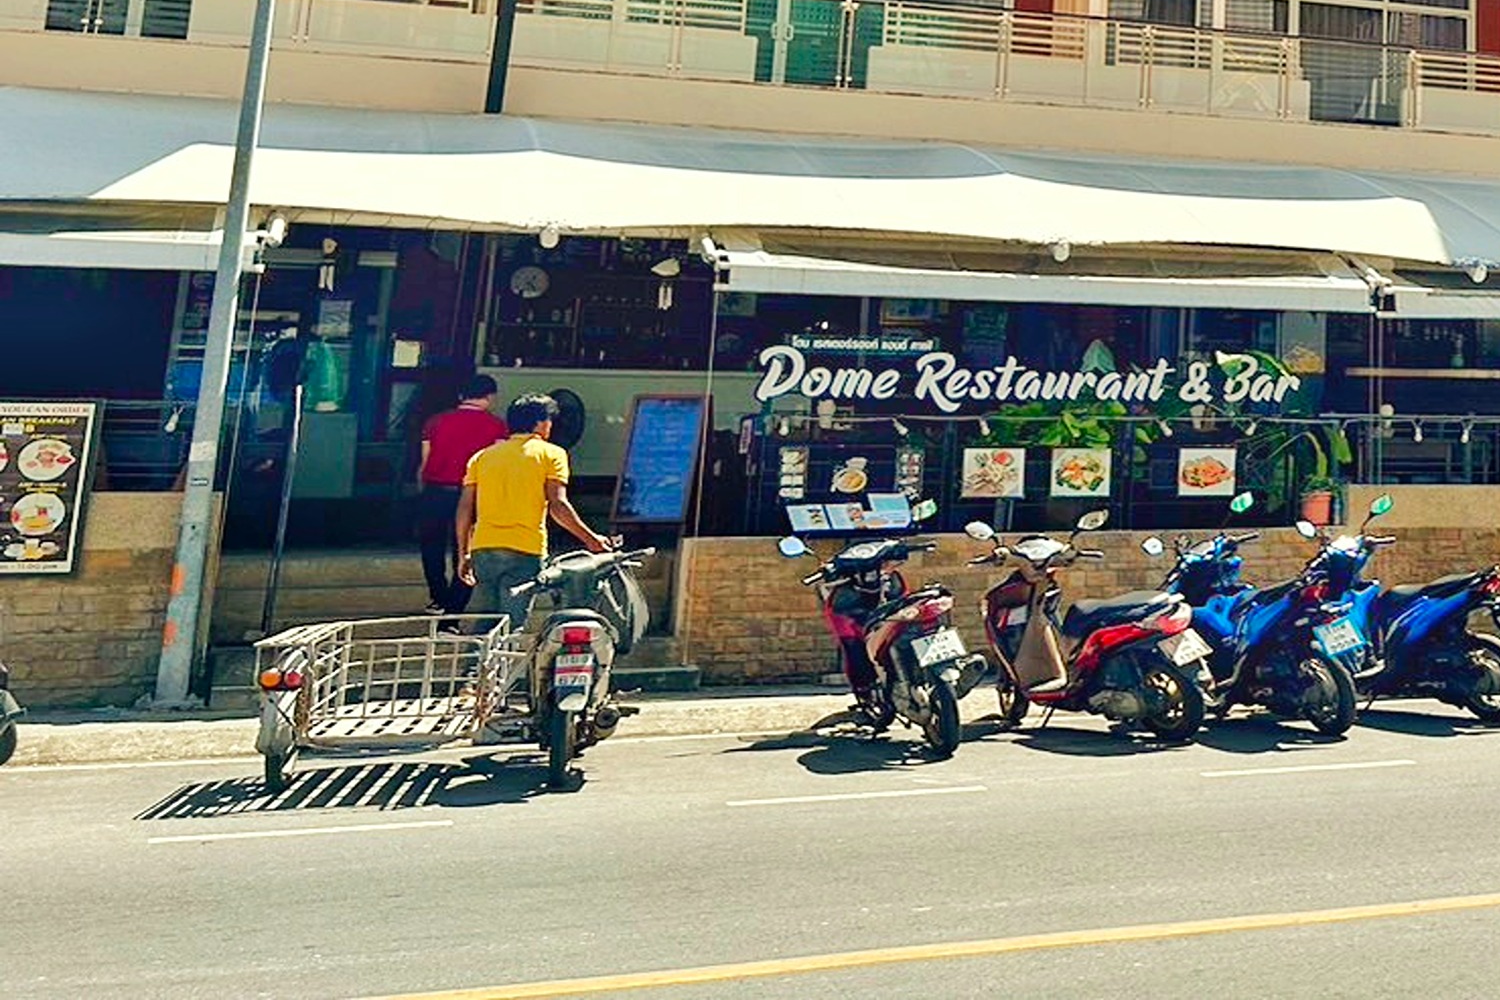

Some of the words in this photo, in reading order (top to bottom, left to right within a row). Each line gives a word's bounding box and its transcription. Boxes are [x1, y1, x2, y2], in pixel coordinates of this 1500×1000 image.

[756, 345, 900, 402] Dome
[914, 352, 1176, 413] Restaurant
[1179, 362, 1213, 402] &
[1218, 352, 1300, 402] Bar
[26, 405, 50, 413] CAN
